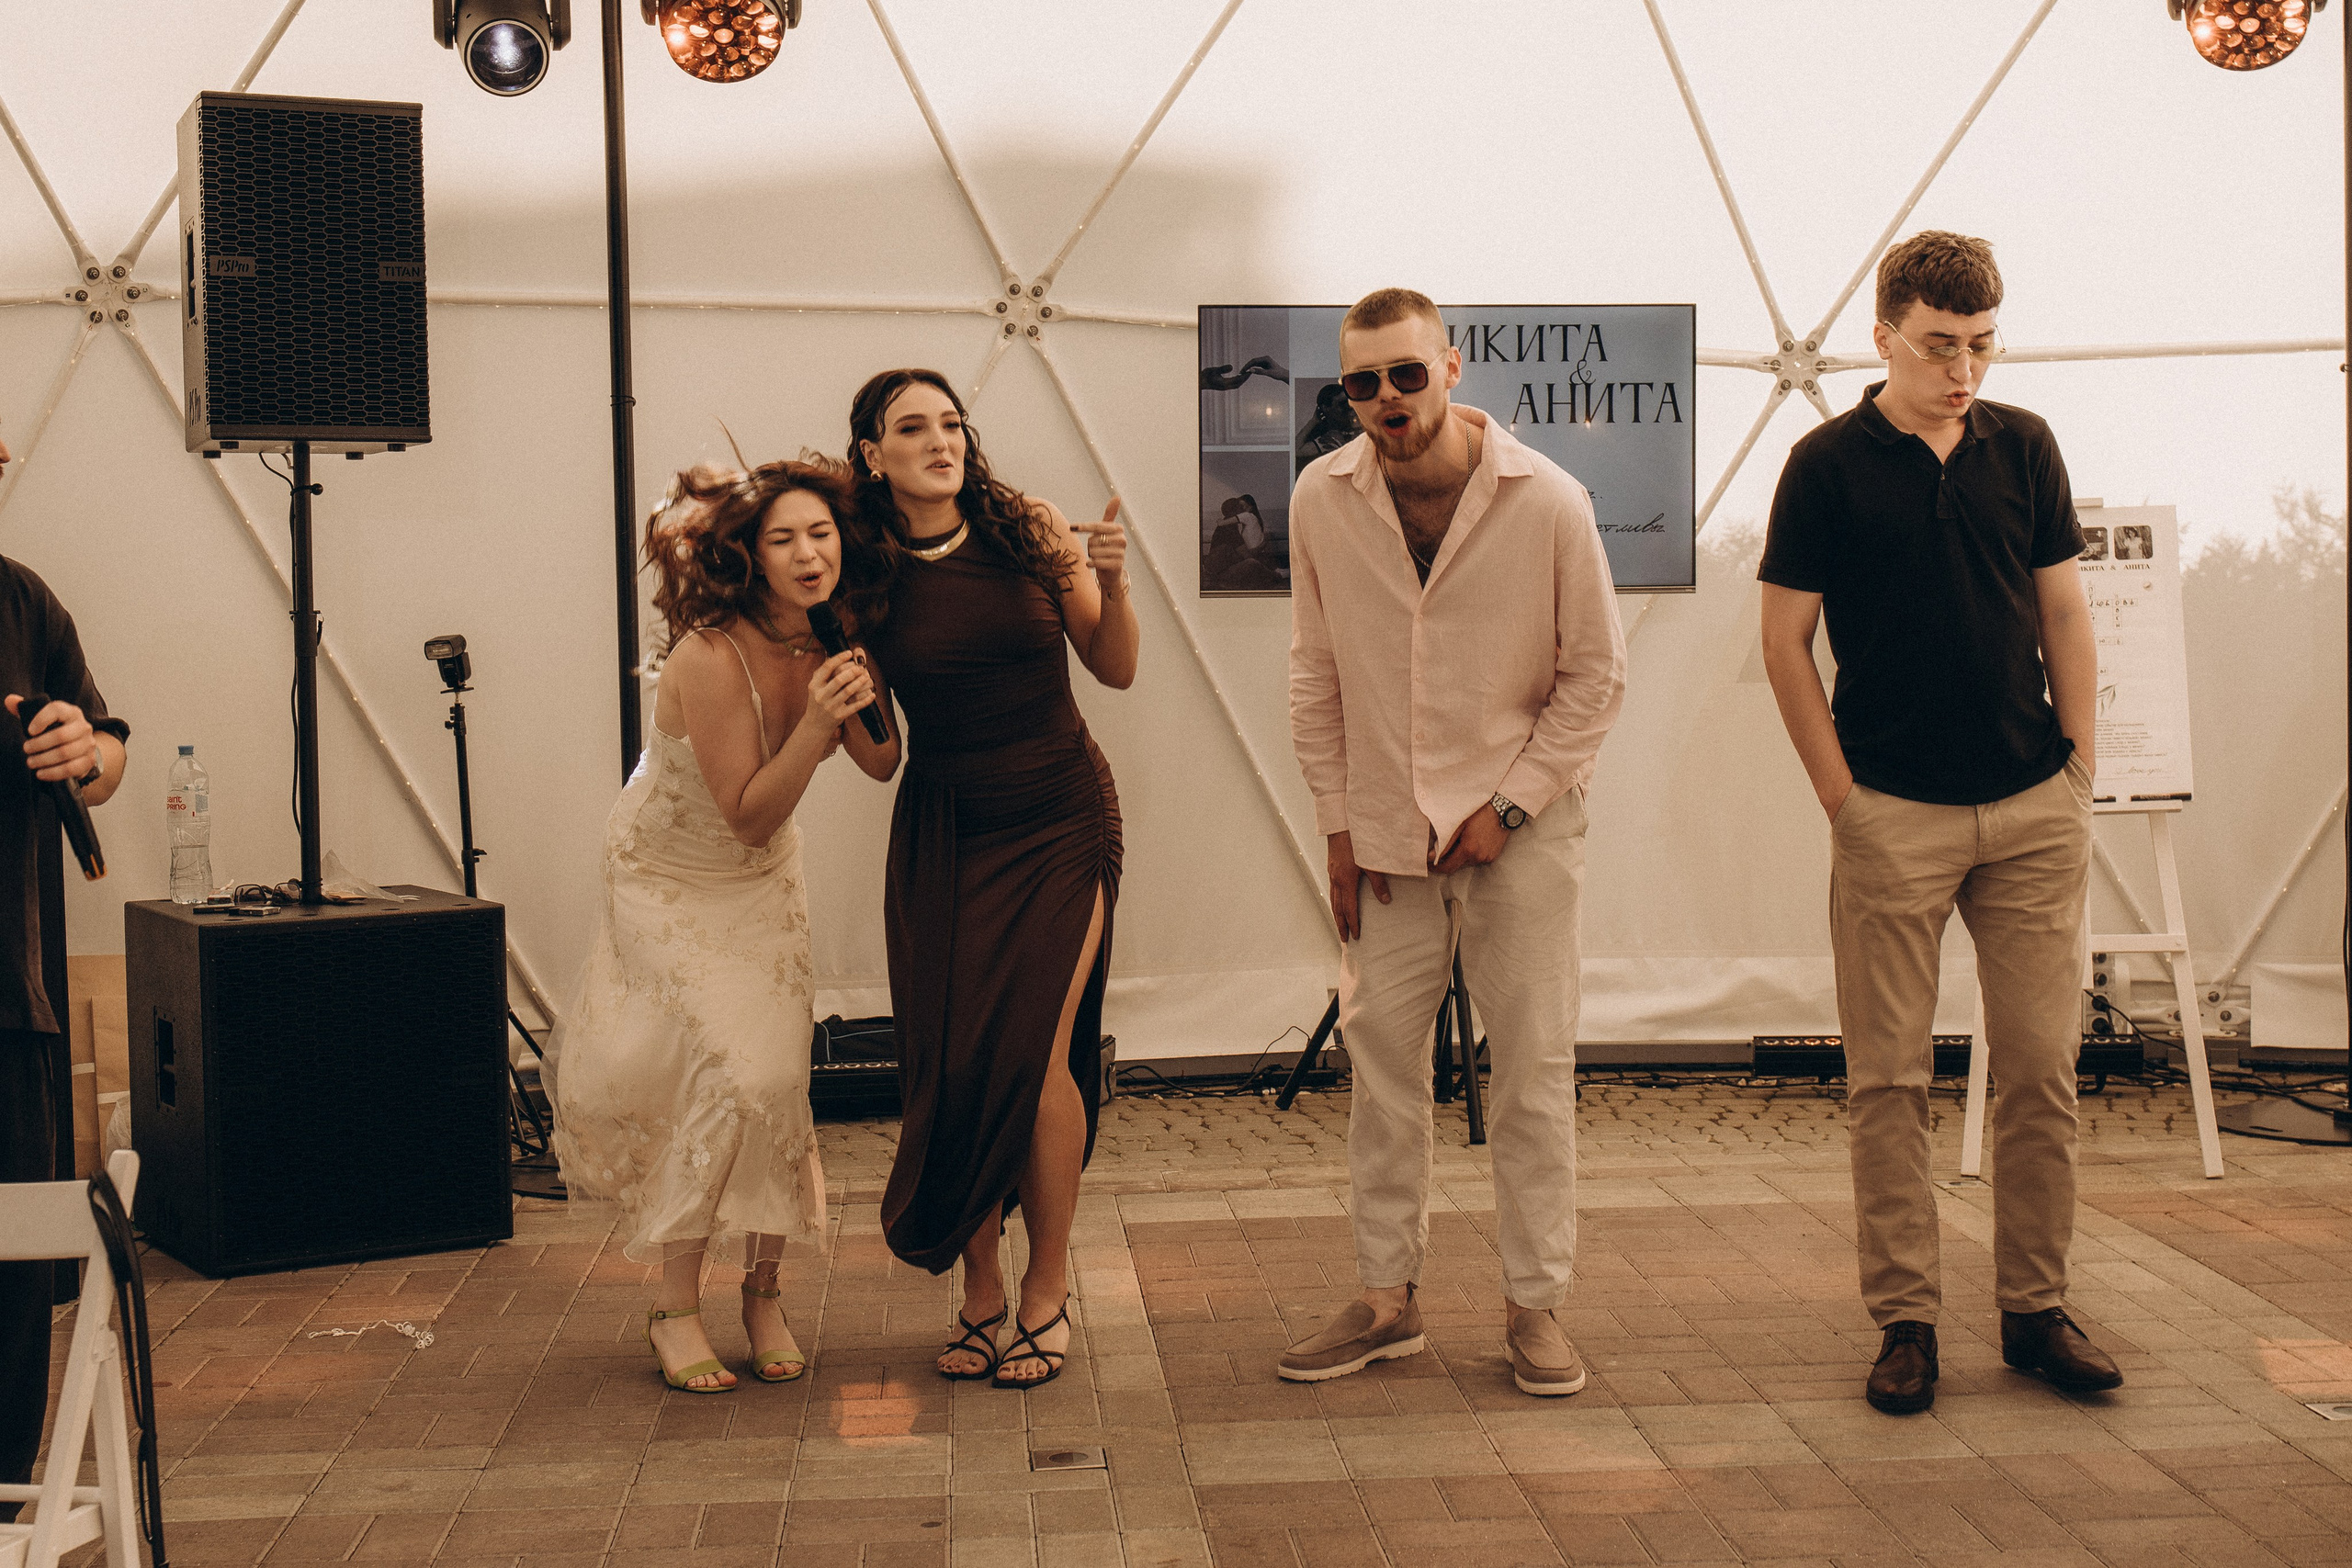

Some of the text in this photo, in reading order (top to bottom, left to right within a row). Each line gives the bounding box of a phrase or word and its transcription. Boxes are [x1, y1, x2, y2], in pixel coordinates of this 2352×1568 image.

[216, 258, 250, 274] PSPro
[382, 265, 421, 277] TITAN
[1447, 323, 1609, 363] ИКИТА
[1568, 359, 1597, 386] &
[1510, 381, 1684, 424] АНИТА
